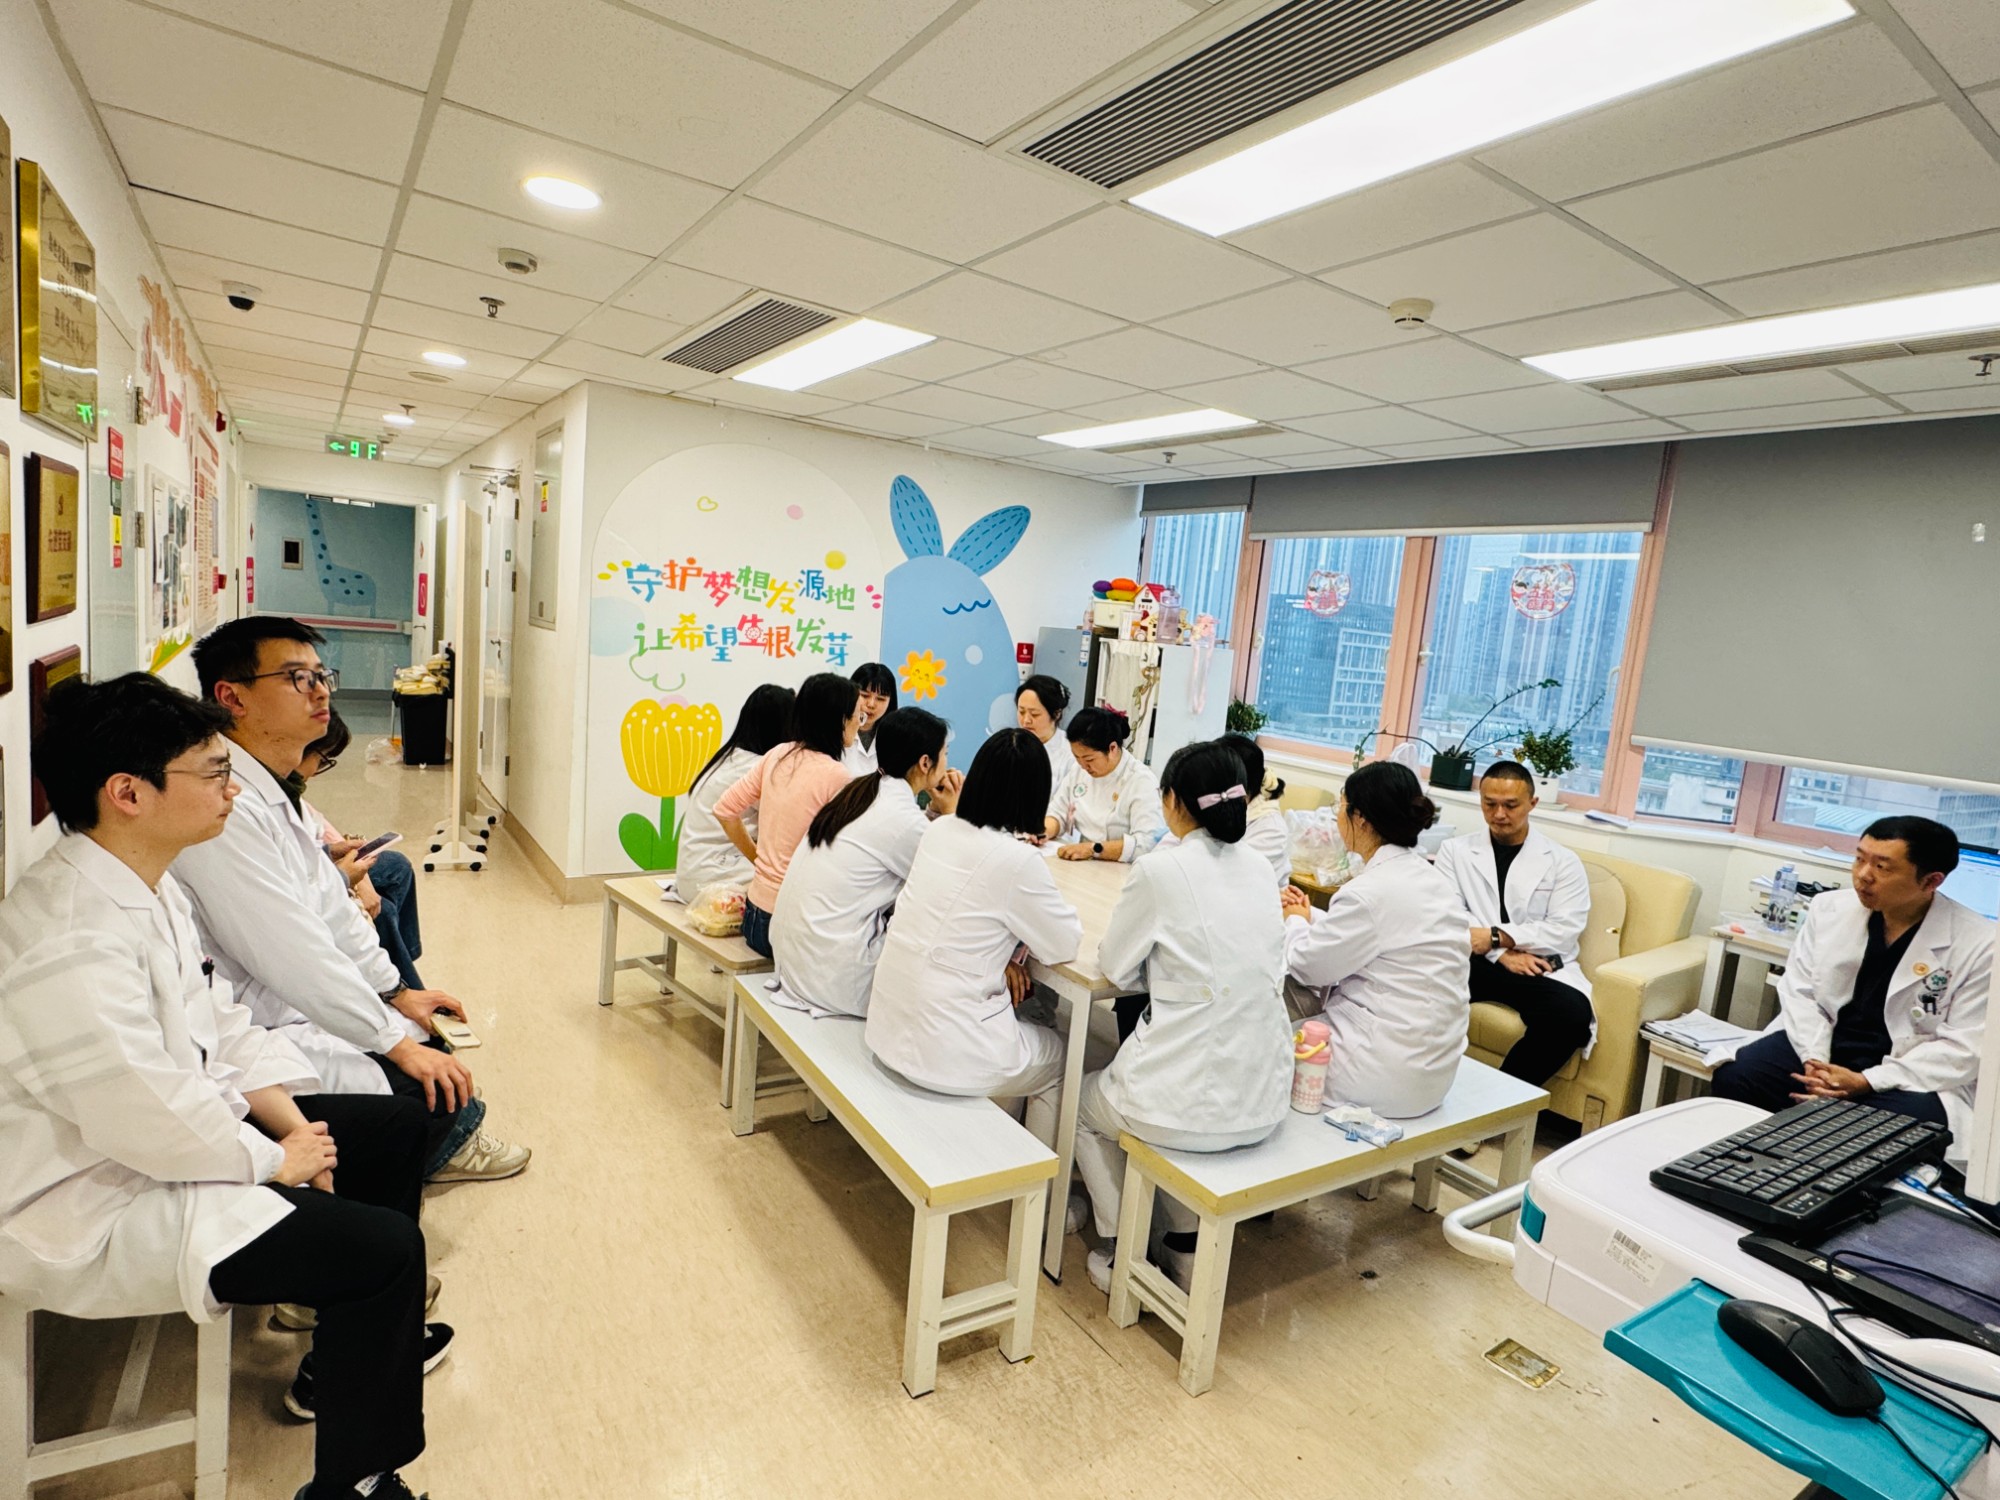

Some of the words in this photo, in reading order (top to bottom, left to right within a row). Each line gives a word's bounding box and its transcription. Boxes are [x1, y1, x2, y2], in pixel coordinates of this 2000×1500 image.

[626, 557, 855, 615] 守护梦想发源地
[634, 612, 853, 667] 让希望生根发芽
